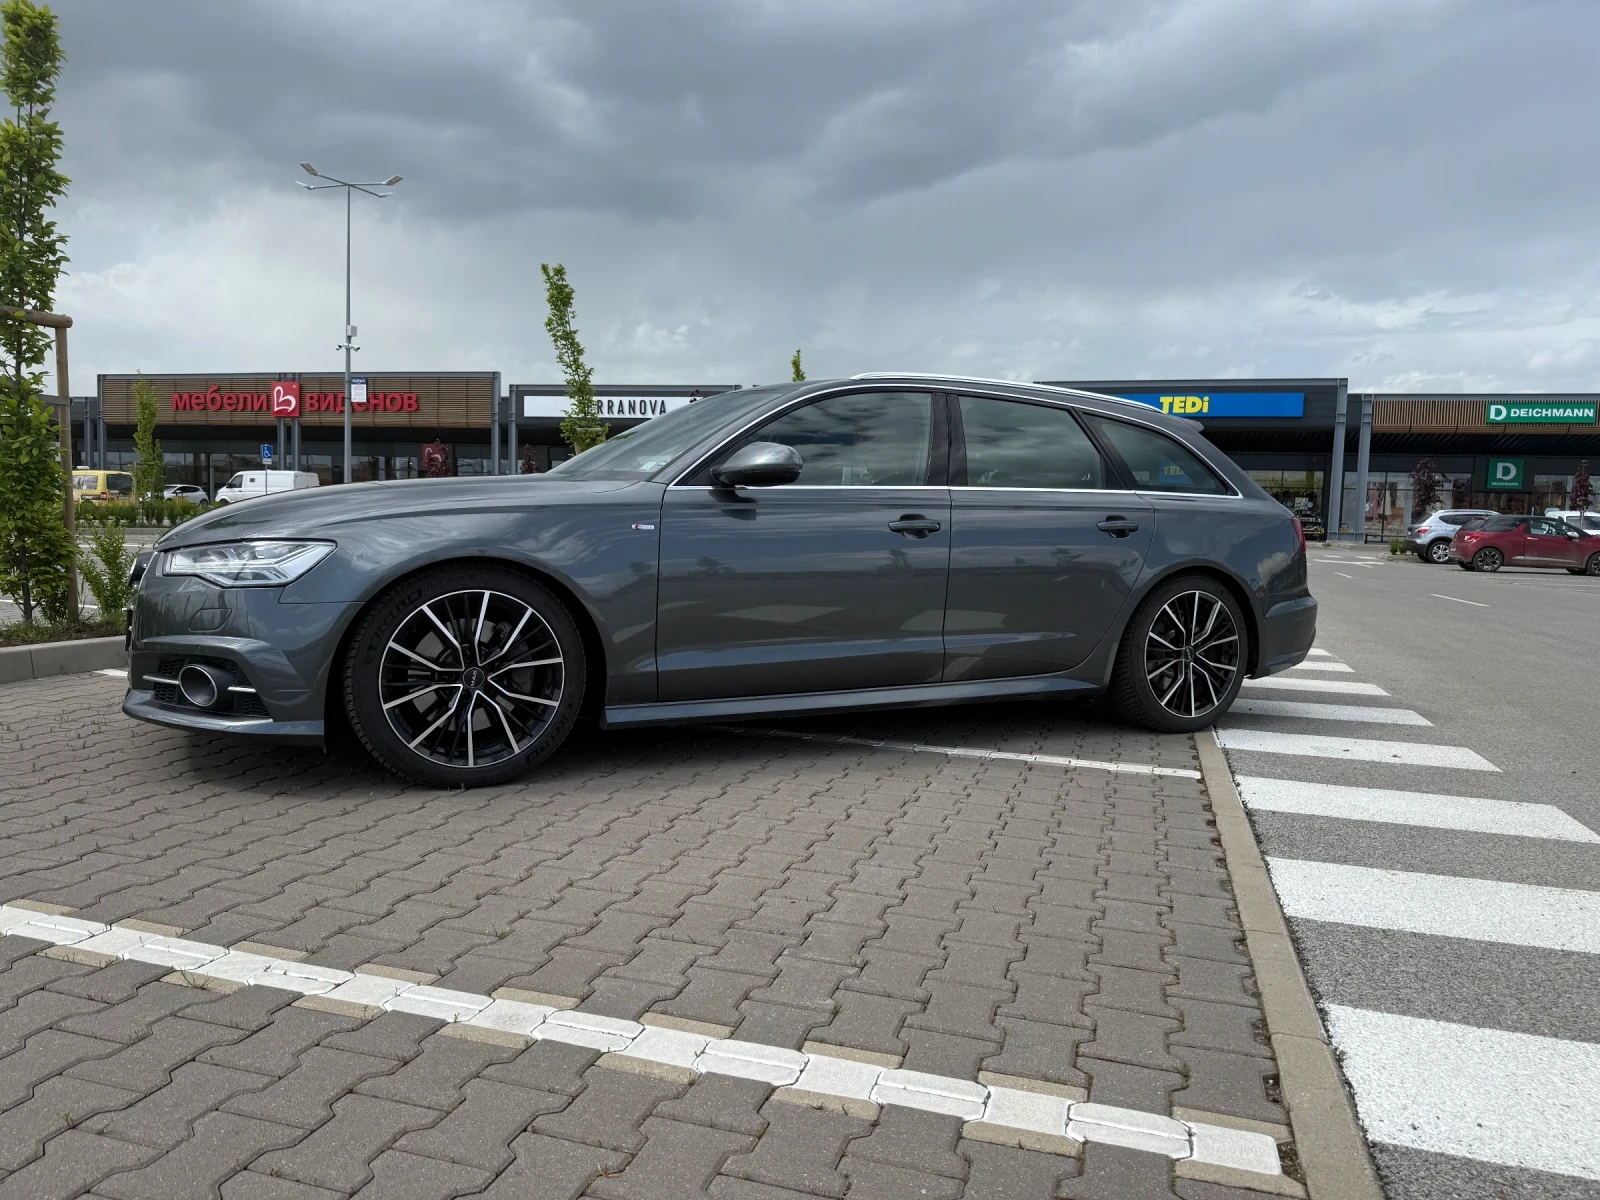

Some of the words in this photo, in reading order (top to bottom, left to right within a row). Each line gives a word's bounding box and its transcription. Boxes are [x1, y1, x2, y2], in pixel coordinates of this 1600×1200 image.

[172, 384, 268, 411] мебели
[1160, 396, 1209, 414] TEDi
[1510, 408, 1594, 417] DEICHMANN
